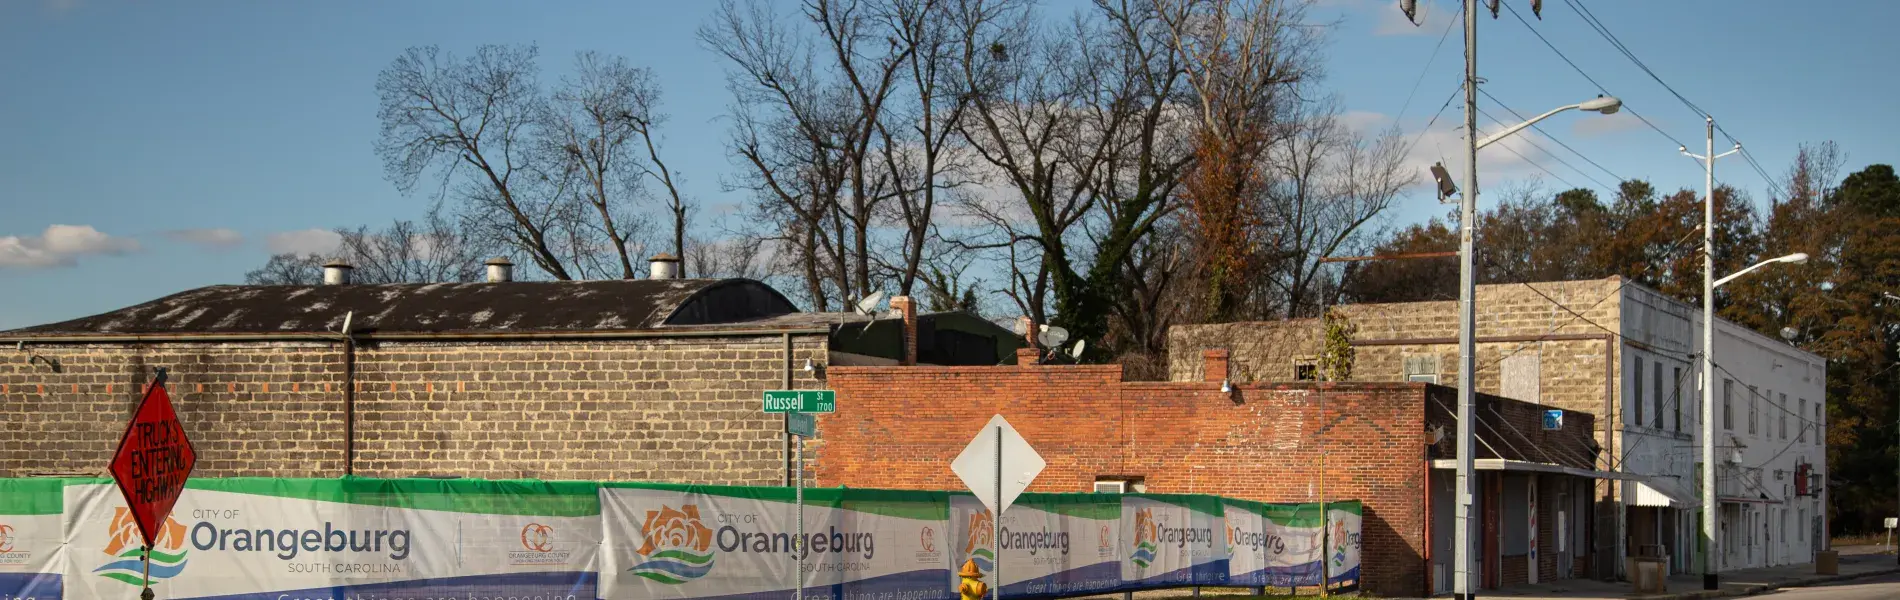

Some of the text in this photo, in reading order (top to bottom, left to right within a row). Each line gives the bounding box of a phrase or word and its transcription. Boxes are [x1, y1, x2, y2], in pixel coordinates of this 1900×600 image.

[765, 391, 824, 410] Russell St
[816, 402, 833, 411] 1700
[136, 420, 179, 448] TRUCKS
[132, 445, 186, 479] ENTERING
[134, 473, 181, 504] HIGHWAY
[192, 509, 240, 519] CITY OF
[717, 514, 759, 523] CITY OF
[190, 521, 411, 560] Orangeburg
[716, 525, 874, 560] Orangeburg
[1000, 526, 1069, 555] Orangeburg
[288, 563, 401, 573] SOUTH CAROLINA
[800, 562, 870, 572] SOUTH CAROLINA
[879, 591, 893, 600] are
[1026, 582, 1047, 594] Great
[1072, 581, 1084, 591] are
